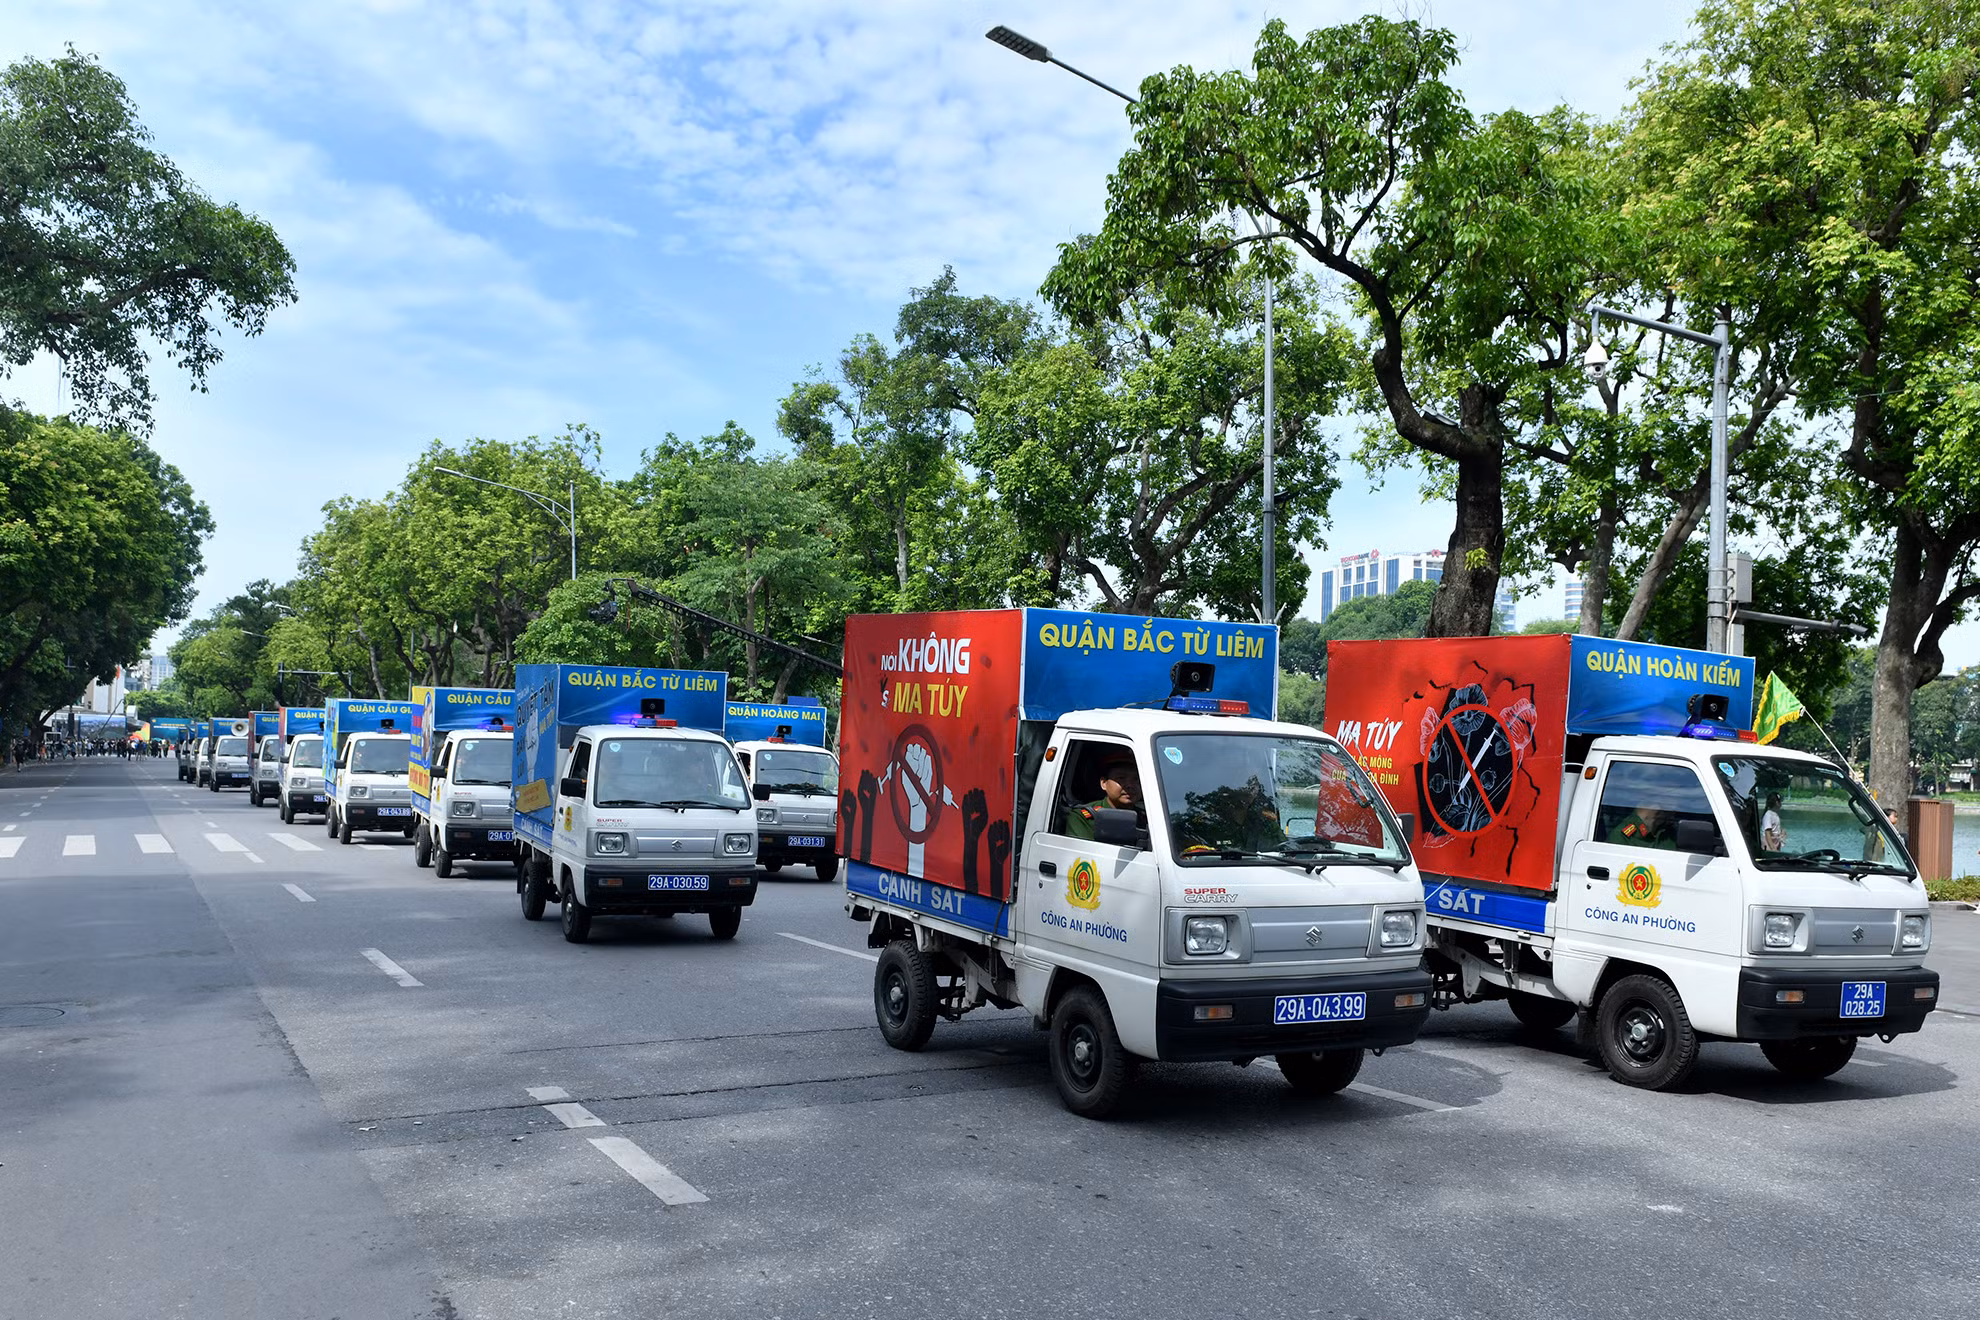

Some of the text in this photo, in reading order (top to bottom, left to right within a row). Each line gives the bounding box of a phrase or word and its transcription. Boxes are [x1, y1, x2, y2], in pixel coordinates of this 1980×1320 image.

[1040, 618, 1264, 659] QUẬN BẮC TỪ LIÊM
[897, 631, 972, 674] KHÔNG
[1586, 648, 1741, 687] QUẬN HOÀN KIẾM
[567, 669, 718, 692] QUẬN BẮC TỪ LIÊM
[348, 703, 376, 714] QUẬN
[399, 706, 412, 714] GI
[447, 692, 481, 707] QUẬN
[893, 678, 969, 717] MA TÚY
[728, 705, 821, 720] QUẬN HOÀNG MAI
[1336, 717, 1403, 752] MA TÚY
[1369, 754, 1393, 770] MỘNG
[1380, 771, 1399, 785] ĐÌNH
[650, 876, 707, 888] 29A-030.59
[1184, 894, 1238, 903] CARRY
[1438, 888, 1486, 915] SÁT
[1041, 910, 1127, 943] CÔNG AN PHƯỜNG
[1585, 906, 1696, 933] CÔNG AN PHƯỜNG
[1854, 984, 1873, 999] 29A
[1277, 995, 1363, 1020] 29A-043.99
[1845, 1000, 1881, 1015] 028.25
